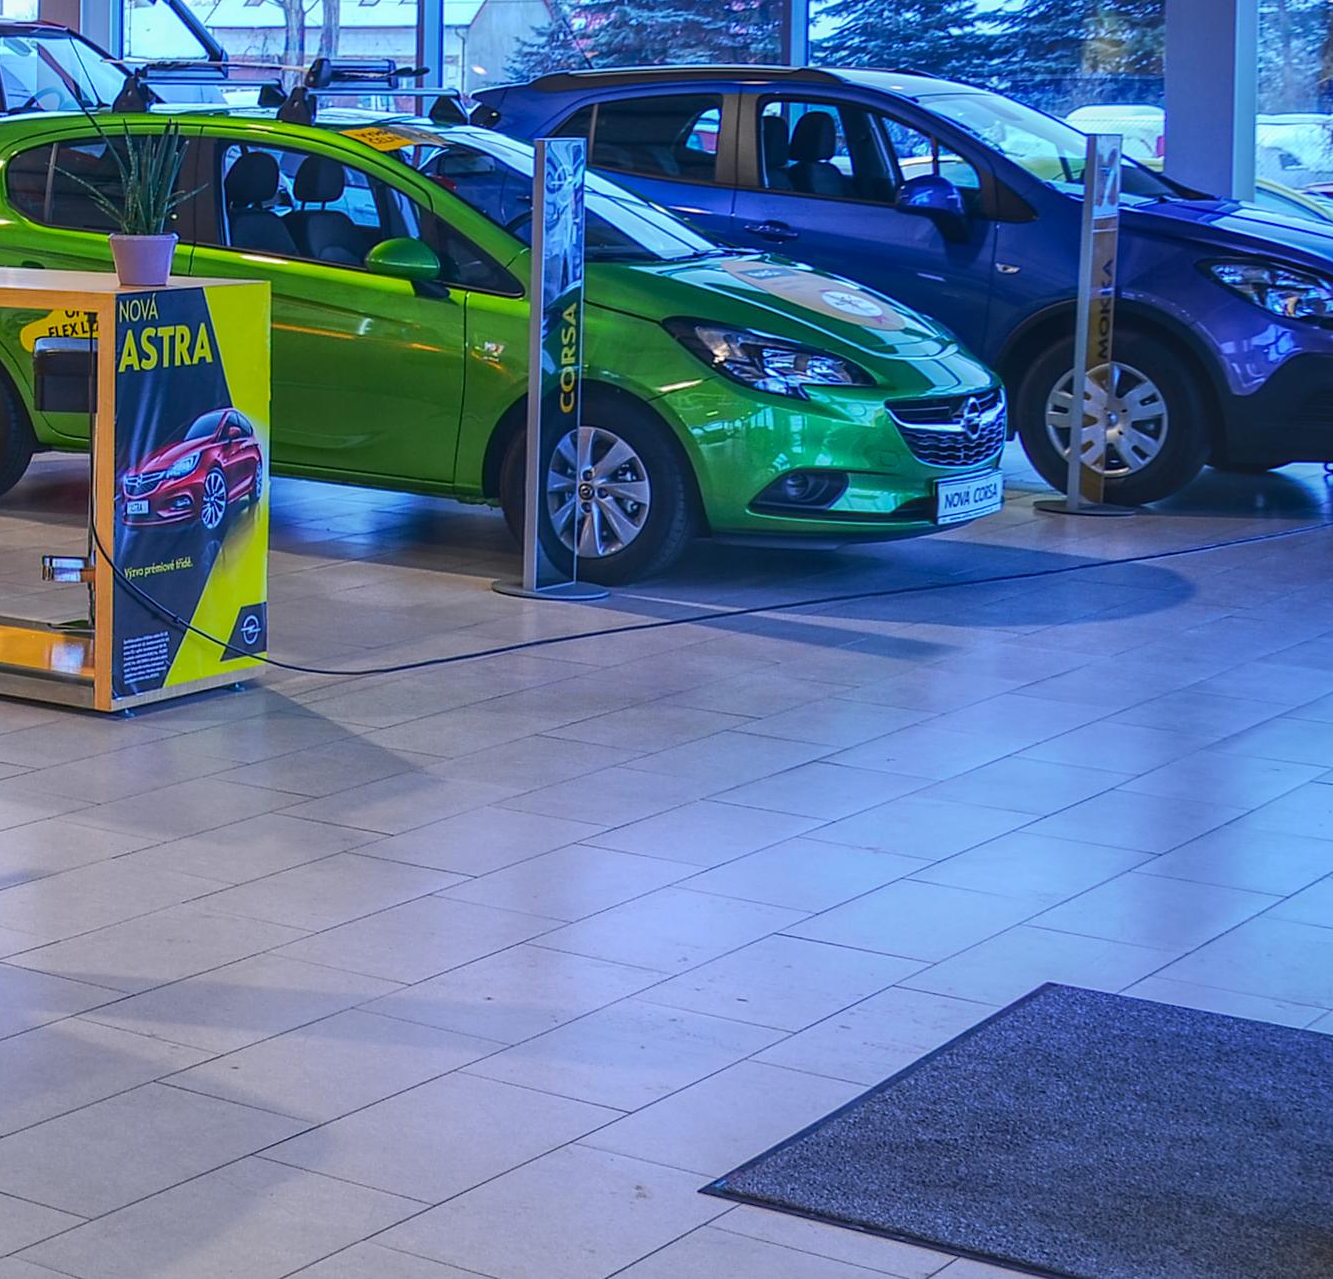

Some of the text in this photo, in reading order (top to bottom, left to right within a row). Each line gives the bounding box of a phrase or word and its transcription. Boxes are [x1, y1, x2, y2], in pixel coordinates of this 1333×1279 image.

[119, 293, 159, 323] NOVÁ
[1097, 259, 1114, 360] MOKKA
[48, 321, 79, 337] FLEX
[118, 323, 214, 372] ASTRA
[560, 302, 577, 413] CORSA
[944, 485, 970, 509] NOVÁ
